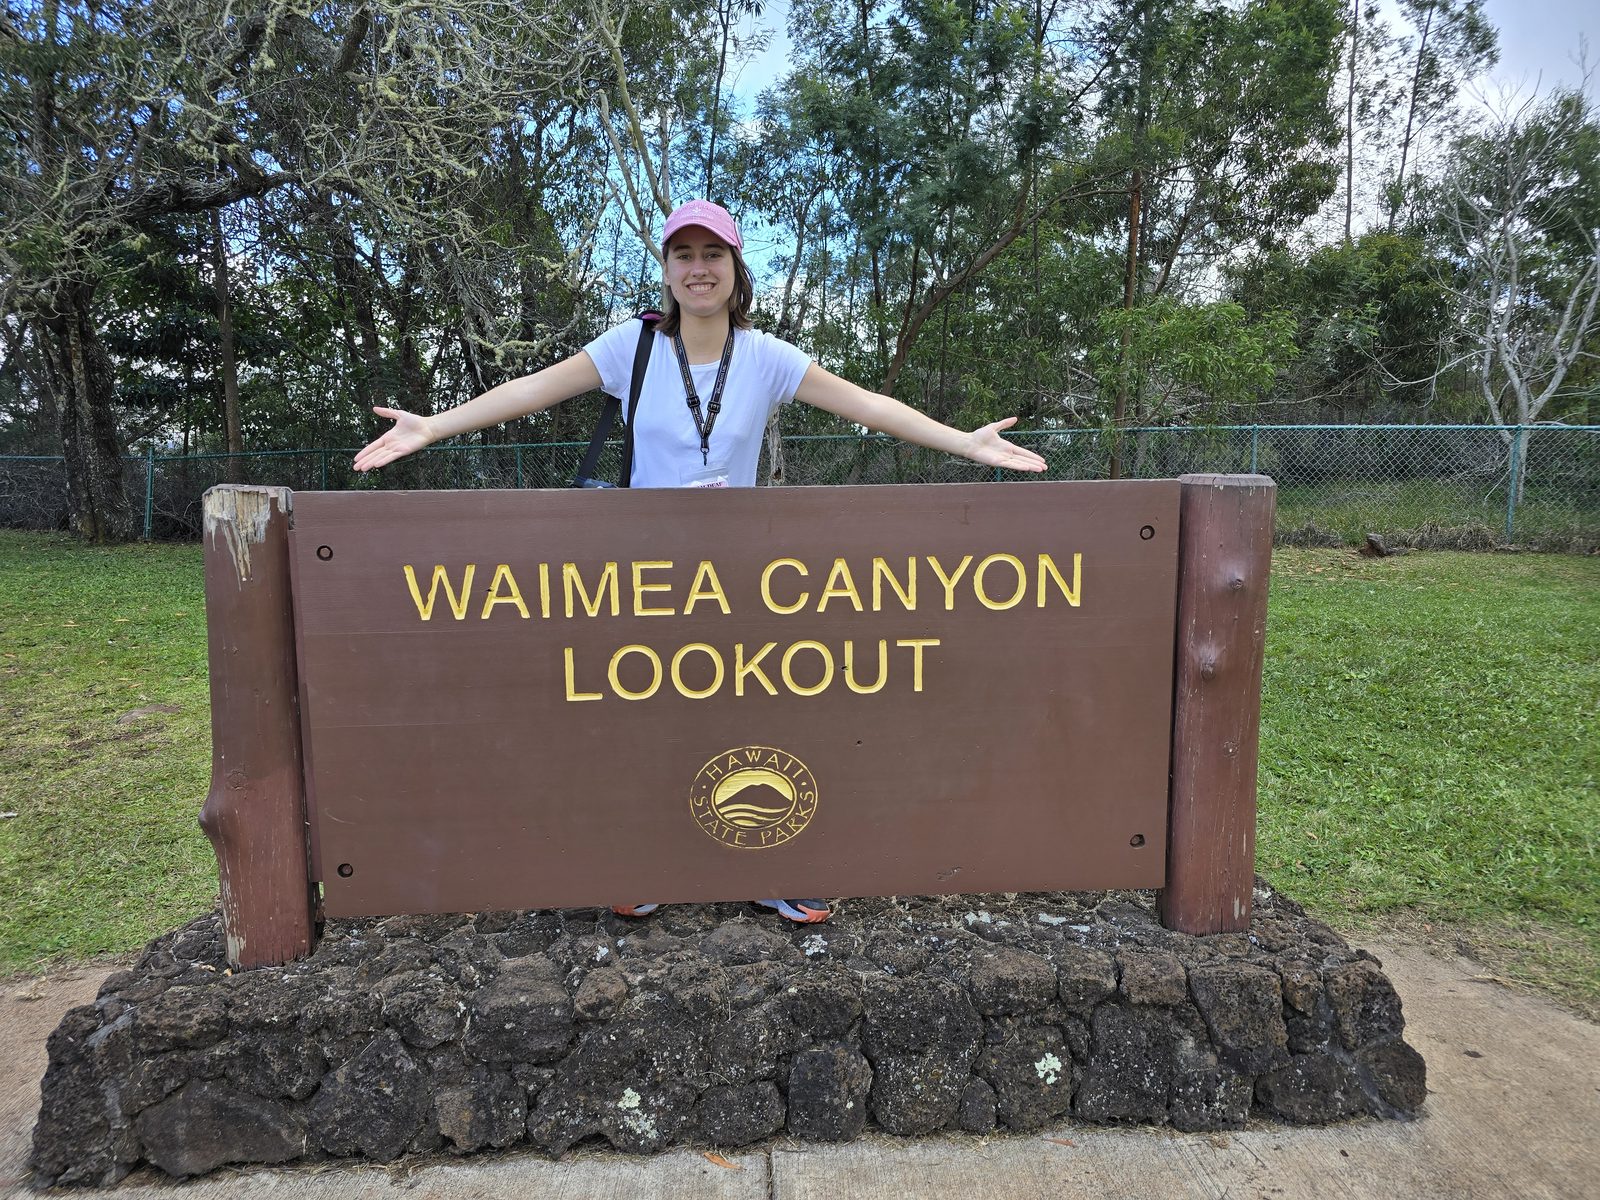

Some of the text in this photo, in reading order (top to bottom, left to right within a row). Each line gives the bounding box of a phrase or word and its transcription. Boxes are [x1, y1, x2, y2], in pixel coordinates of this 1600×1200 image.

[404, 553, 1082, 620] WAIMEA CANYON
[564, 639, 940, 701] LOOKOUT
[705, 750, 804, 780] HAWAII
[693, 791, 815, 844] STATE PARKS
